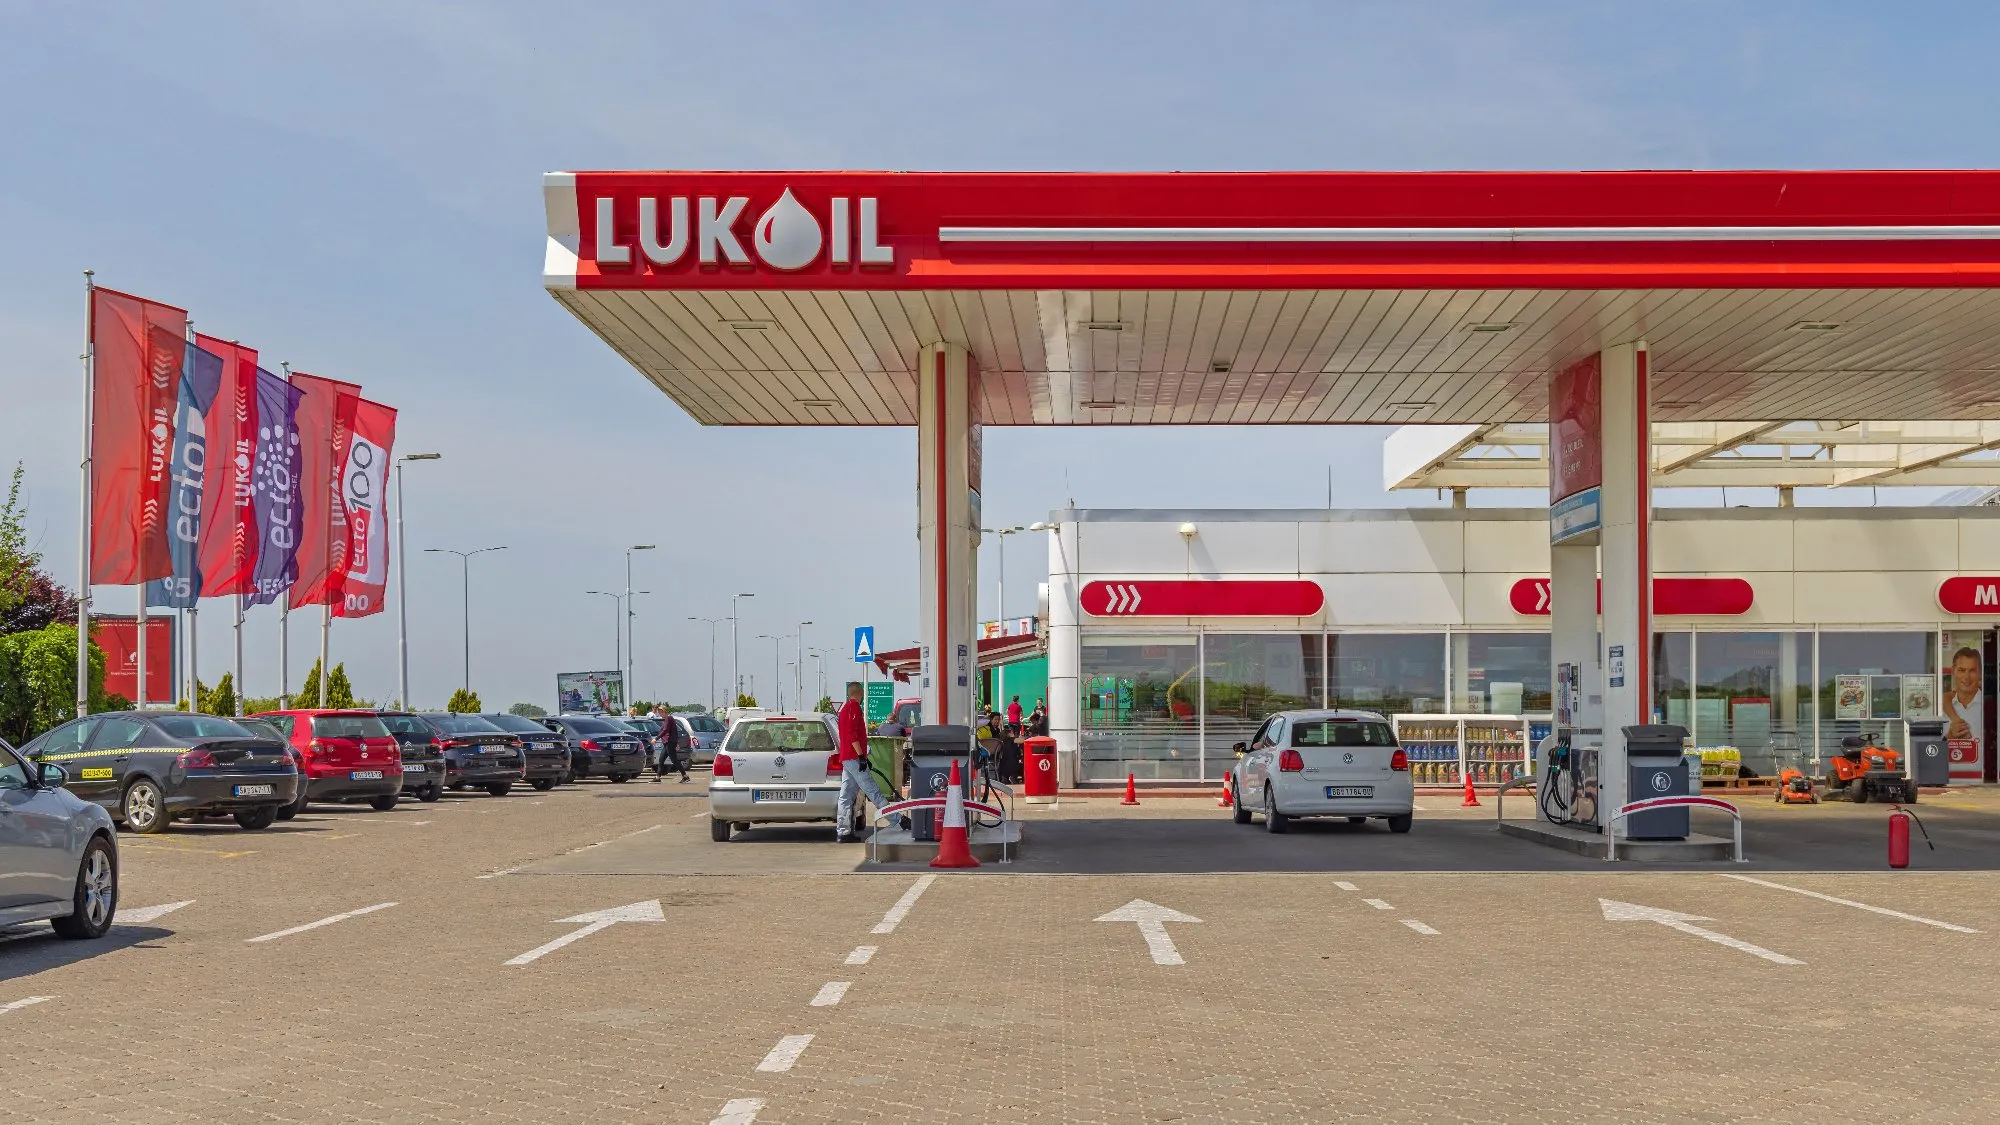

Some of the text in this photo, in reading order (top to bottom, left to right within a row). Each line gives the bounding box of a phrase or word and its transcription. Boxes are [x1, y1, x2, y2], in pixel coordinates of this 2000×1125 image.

[596, 184, 894, 270] LUKOIL
[150, 406, 168, 482] LUKOIL
[233, 438, 250, 507] LUKOIL
[172, 441, 206, 543] ecto
[269, 463, 294, 549] ecto
[348, 442, 373, 567] ecto 100
